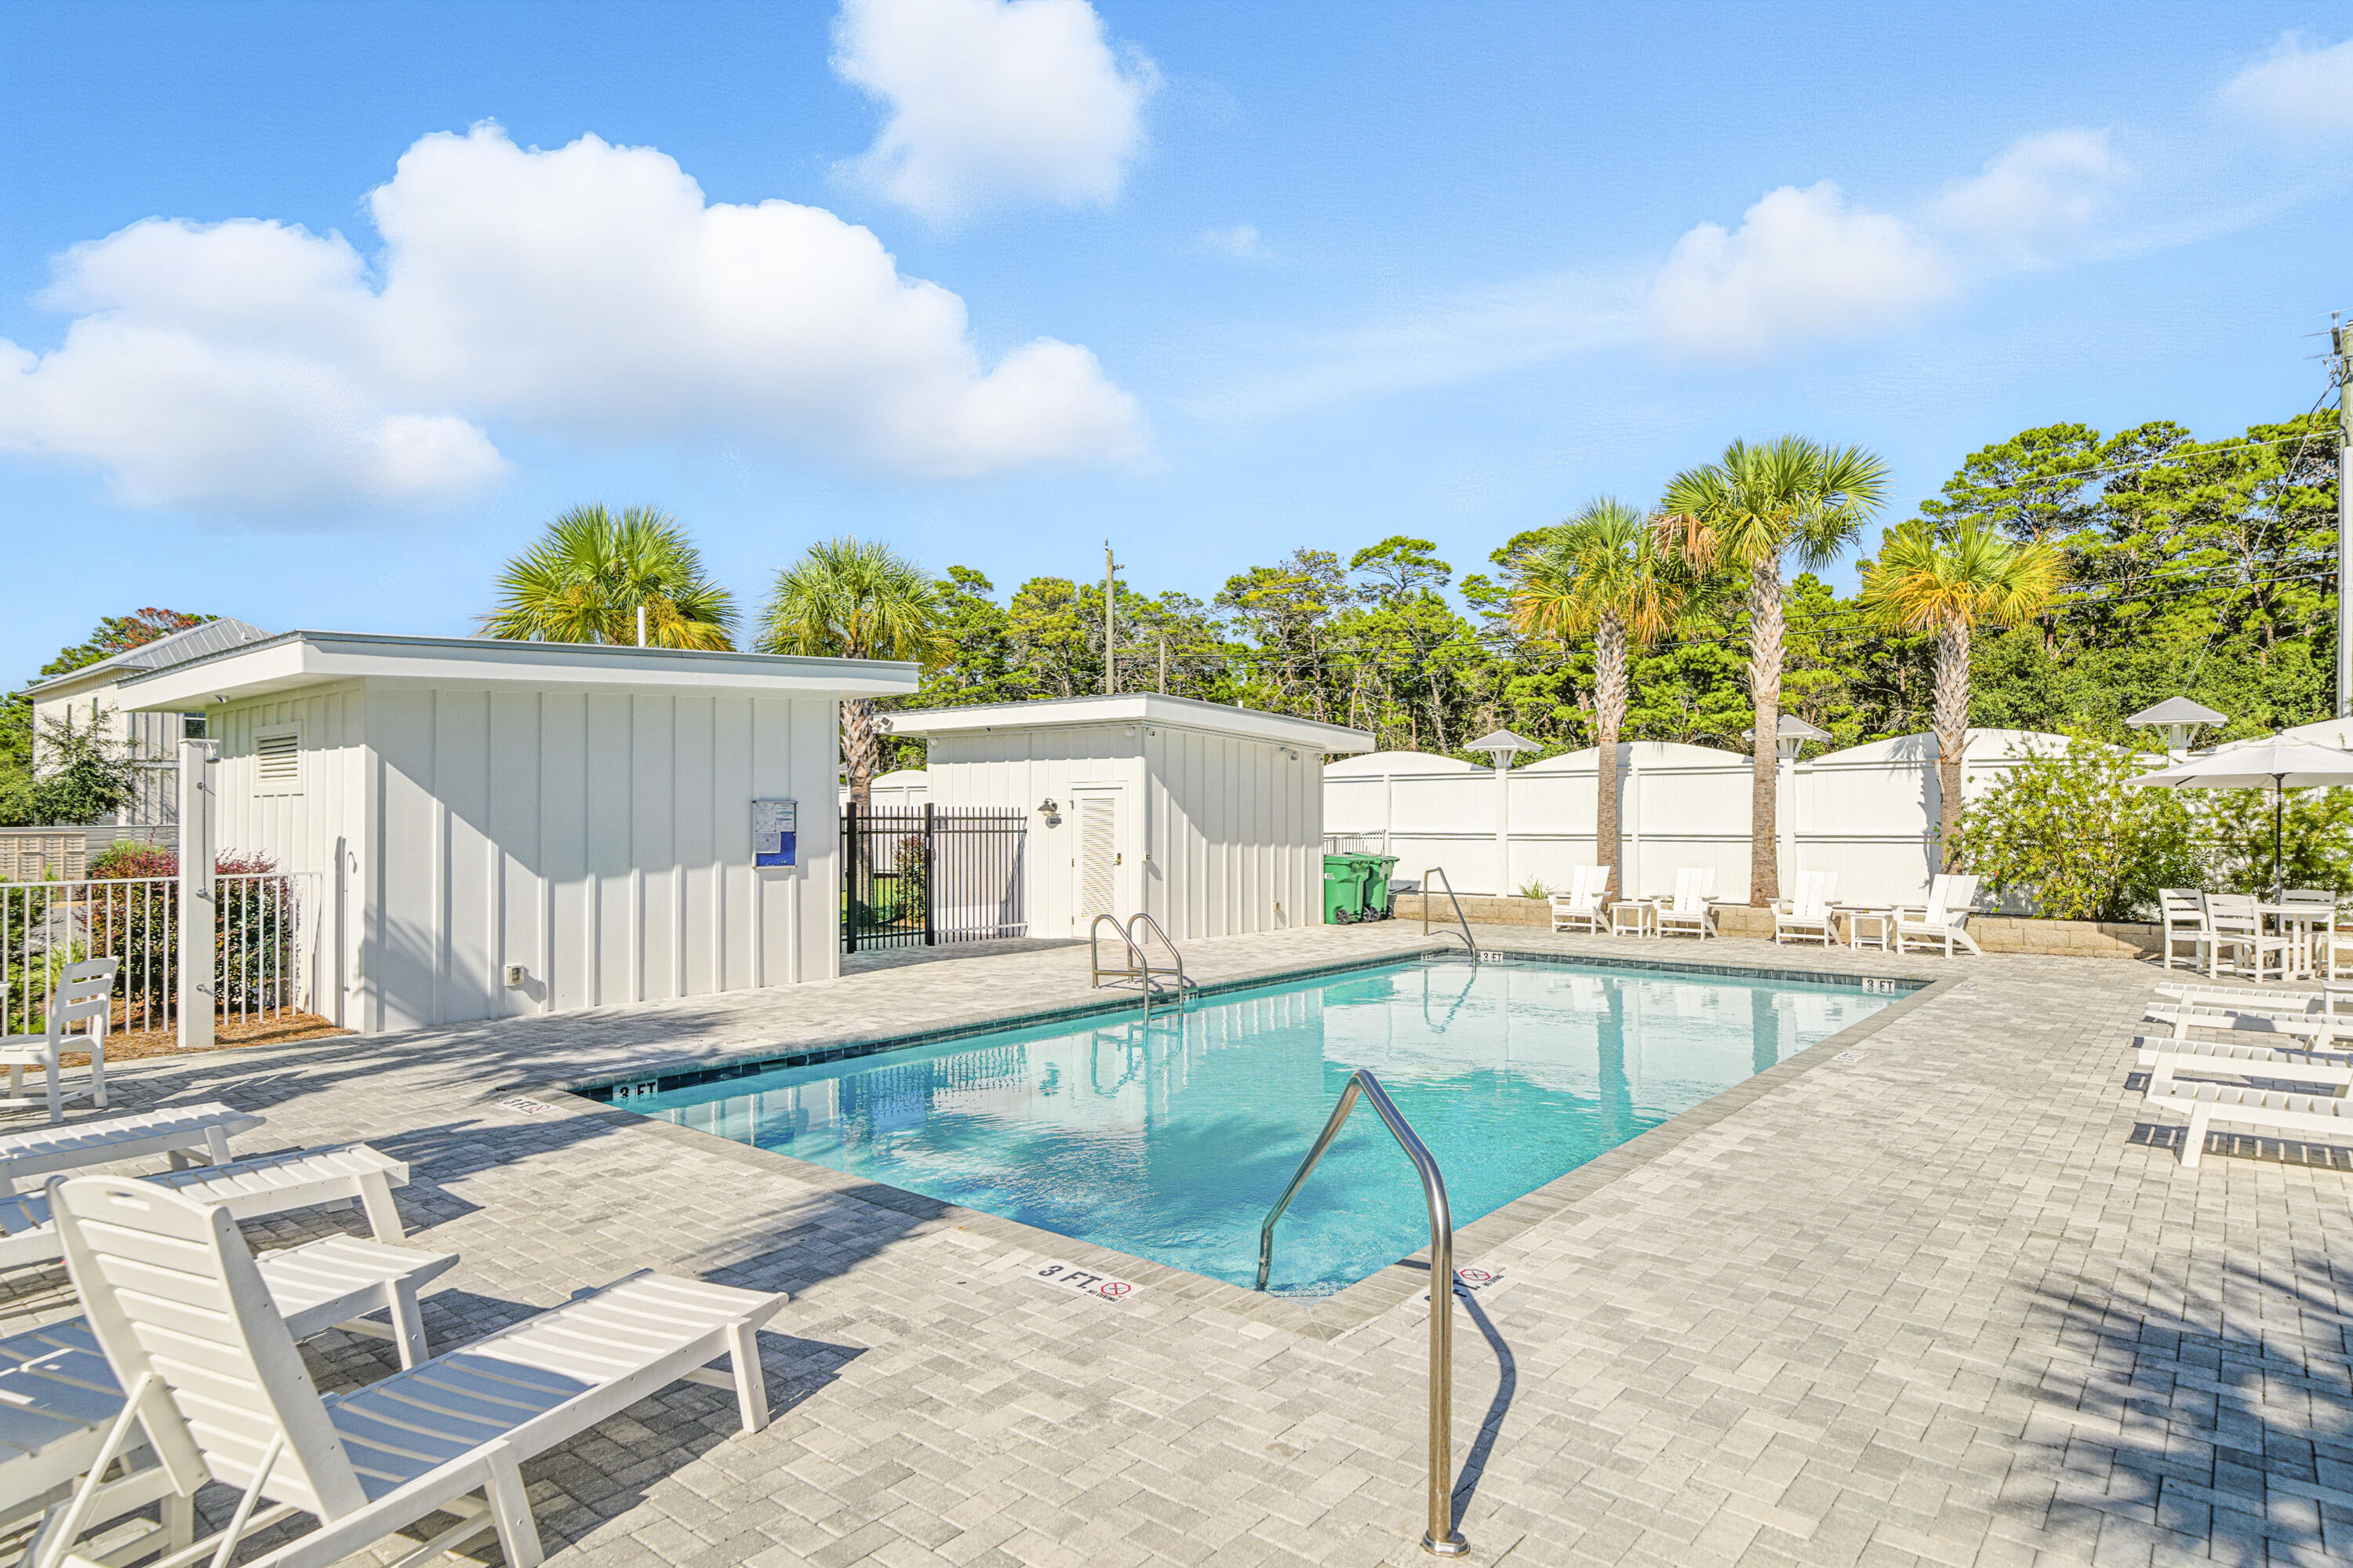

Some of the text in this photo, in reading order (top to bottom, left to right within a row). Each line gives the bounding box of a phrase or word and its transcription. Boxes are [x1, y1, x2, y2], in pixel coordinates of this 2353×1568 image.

[1483, 952, 1502, 962] 3 FT
[1867, 980, 1893, 991] 3 FT
[620, 1082, 656, 1098] 3 FT
[1038, 1265, 1104, 1289] 3 FT.
[1096, 1292, 1118, 1303] DIVING
